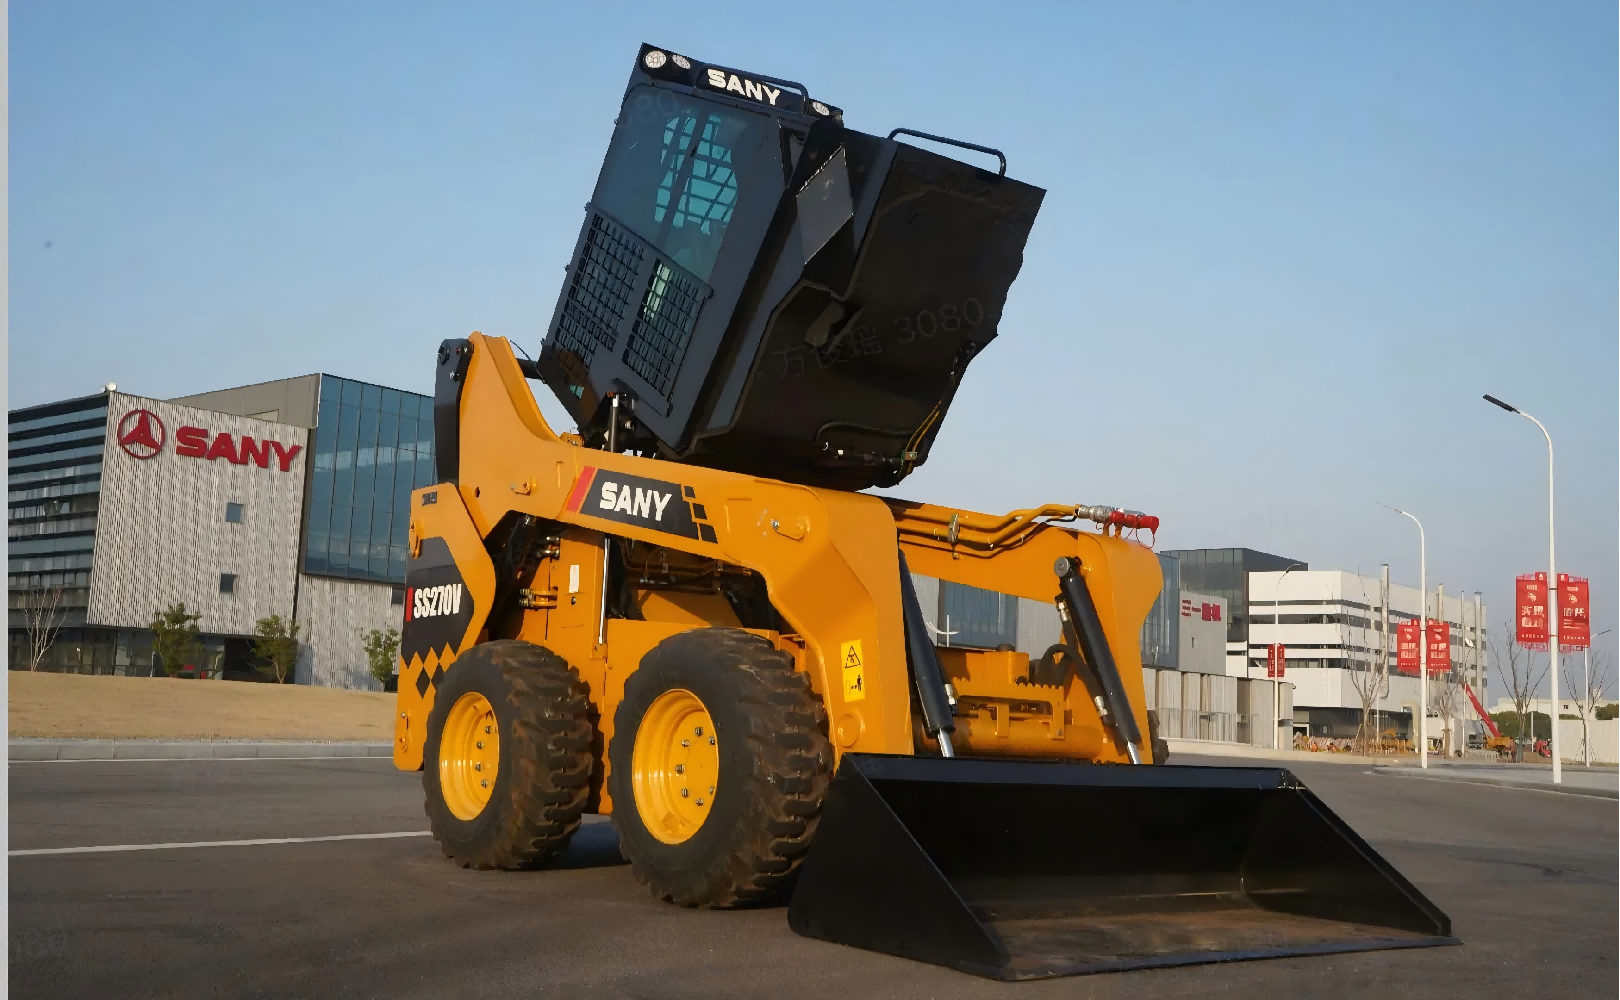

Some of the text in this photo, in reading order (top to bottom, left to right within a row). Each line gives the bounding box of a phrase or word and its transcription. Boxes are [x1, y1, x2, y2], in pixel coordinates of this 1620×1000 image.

[708, 69, 780, 106] SANY
[176, 425, 302, 472] SANY
[600, 481, 672, 521] SANY
[413, 583, 462, 618] SS270V
[1181, 599, 1221, 621] 三一
